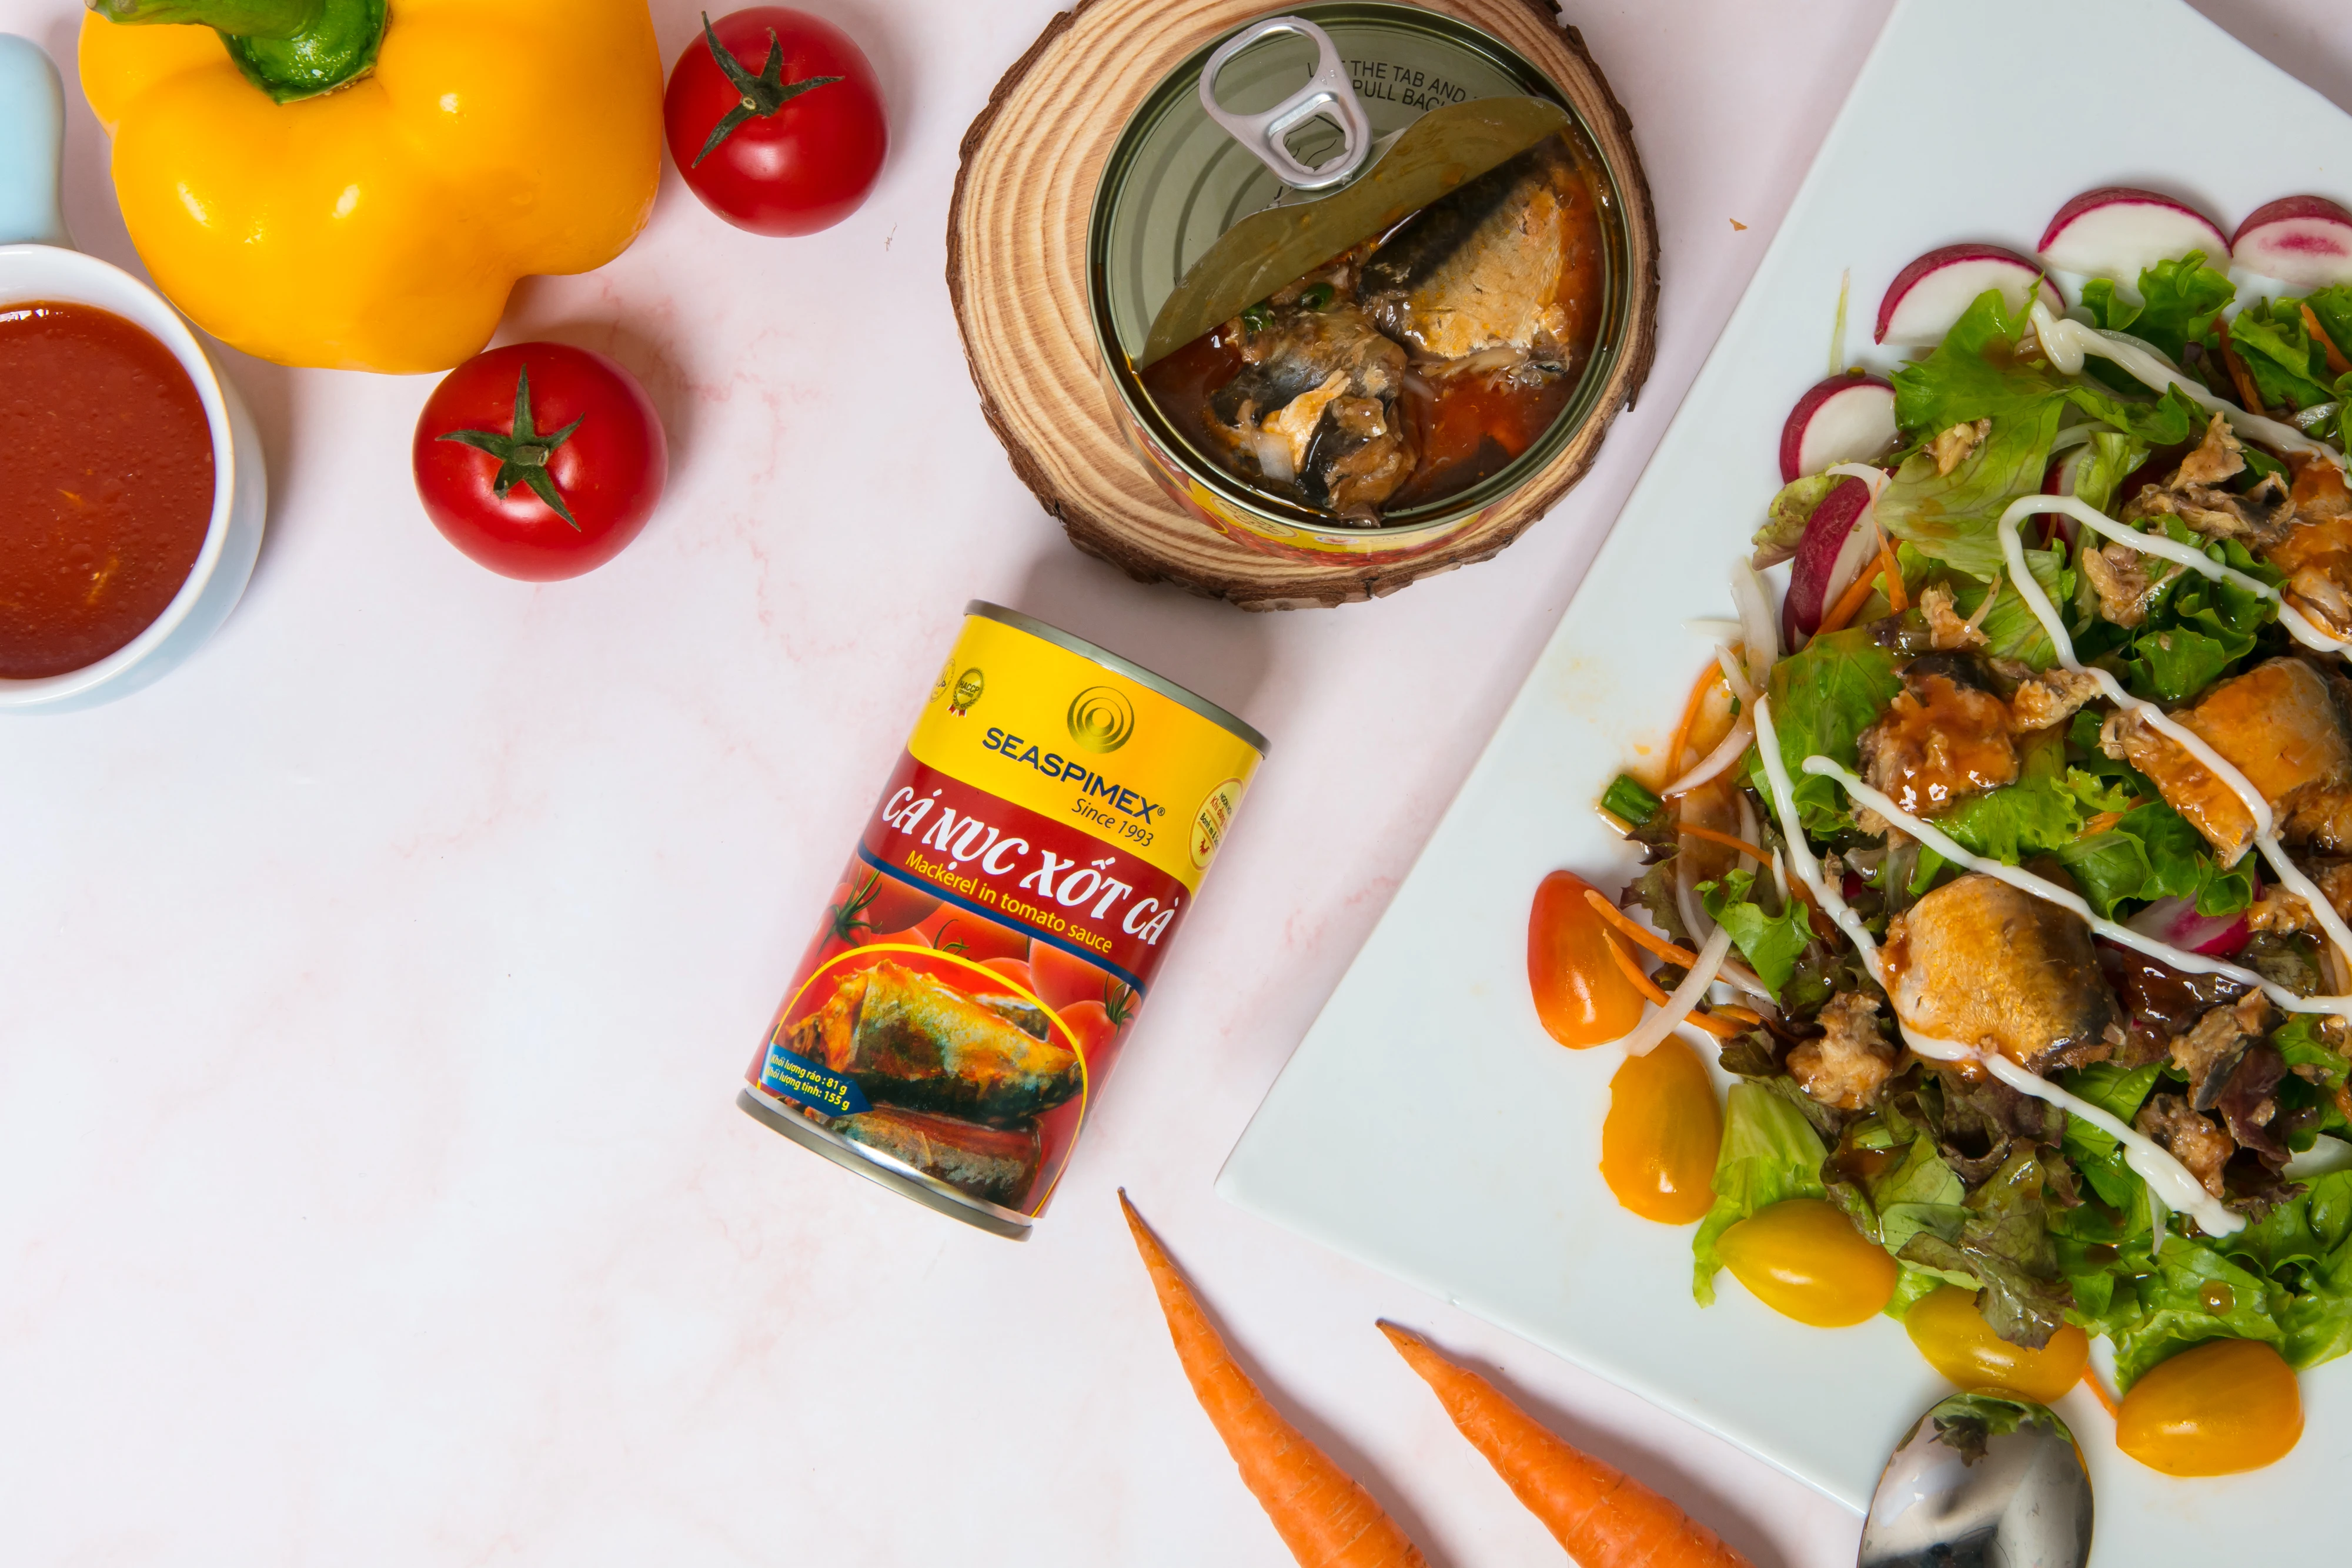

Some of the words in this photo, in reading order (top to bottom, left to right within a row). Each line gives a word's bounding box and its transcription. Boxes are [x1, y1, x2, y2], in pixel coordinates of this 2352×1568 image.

[1350, 60, 1388, 79] THE
[1393, 65, 1425, 87] TAB
[1428, 78, 1466, 103] AND
[1352, 79, 1396, 102] PULL
[1402, 88, 1445, 112] BAC
[958, 681, 980, 693] HACCP
[1071, 798, 1115, 829] Since
[1118, 821, 1154, 847] 1993
[1200, 812, 1211, 830] Bánh
[1210, 795, 1221, 810] Khi
[882, 786, 943, 835] CÁ
[921, 807, 1029, 875] NỤC
[1019, 850, 1133, 920] XỐT
[905, 850, 978, 895] Mackerel
[978, 883, 997, 904] in
[1000, 893, 1065, 932] tomato
[1068, 924, 1112, 953] sauce
[765, 1065, 780, 1079] Khối
[779, 1071, 801, 1091] lượng
[824, 1091, 841, 1105] 155
[841, 1100, 850, 1111] g
[770, 1054, 786, 1066] Khối
[784, 1059, 806, 1078] lượng
[806, 1071, 821, 1083] ráo
[826, 1078, 838, 1090] 81
[839, 1085, 847, 1095] g
